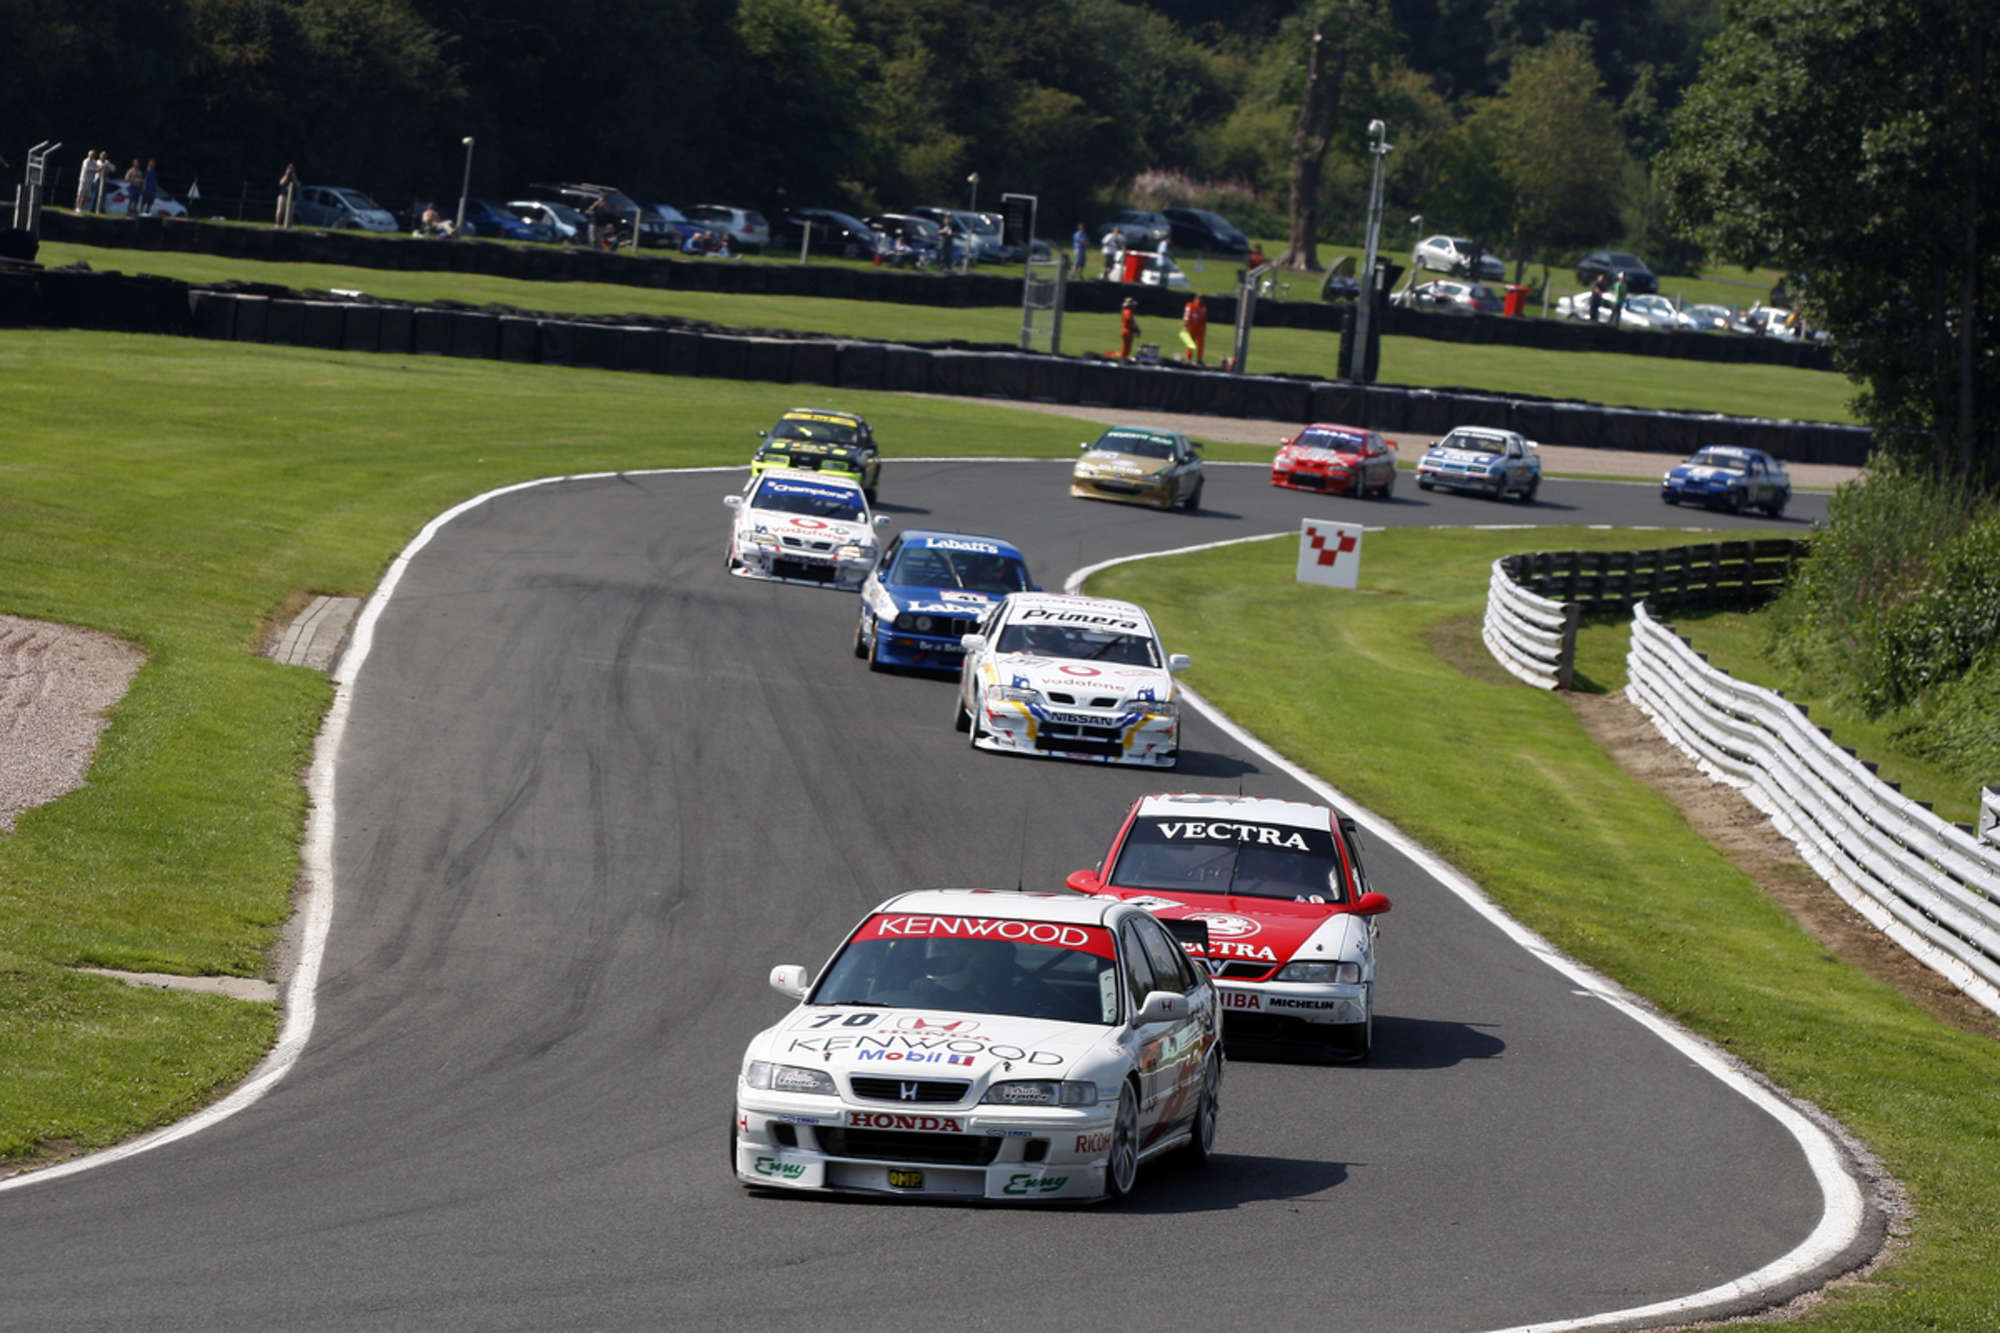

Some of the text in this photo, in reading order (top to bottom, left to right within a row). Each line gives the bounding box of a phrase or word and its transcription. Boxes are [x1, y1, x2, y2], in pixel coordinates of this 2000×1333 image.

[1022, 609, 1138, 629] Primera
[1041, 677, 1127, 692] vodafone
[1050, 711, 1113, 726] NISSAN
[1157, 822, 1311, 851] VECTRA
[877, 916, 1089, 946] KENWOOD
[1269, 998, 1335, 1009] MICHELIN
[810, 1013, 879, 1028] 70
[788, 1035, 1064, 1066] KENWOOD
[857, 1049, 942, 1063] Mobil
[849, 1112, 963, 1133] HONDA
[754, 1156, 807, 1180] Enny
[888, 1171, 922, 1188] OMP
[1002, 1173, 1069, 1195] Enny
